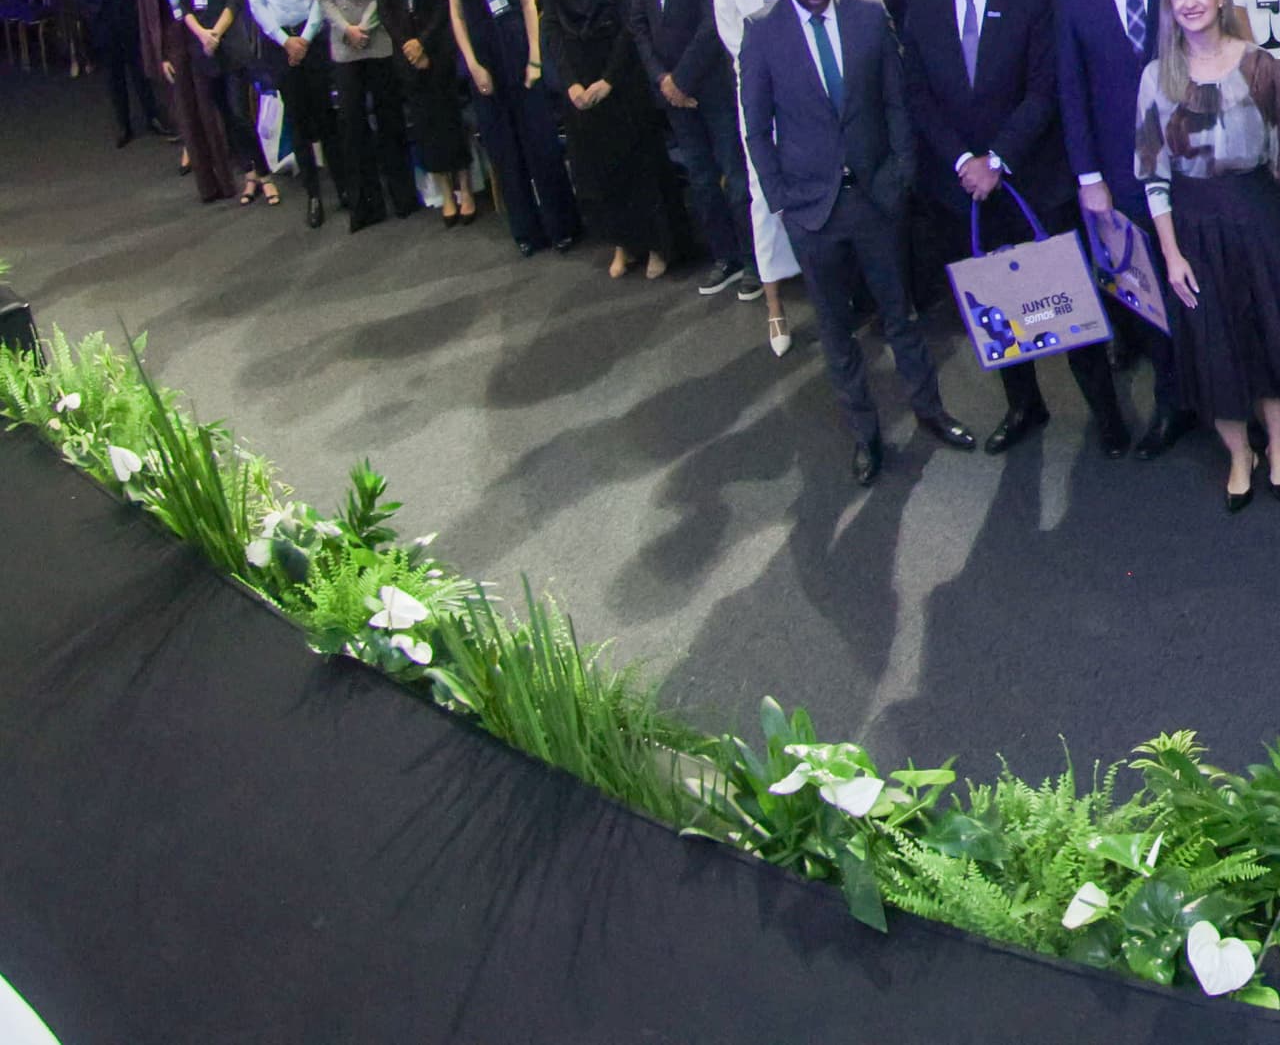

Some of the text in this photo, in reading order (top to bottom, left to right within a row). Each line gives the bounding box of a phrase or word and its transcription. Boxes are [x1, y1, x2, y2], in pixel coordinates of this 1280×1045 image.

[1021, 291, 1073, 315] JUNTOS,
[1024, 303, 1073, 325] somos RIB
